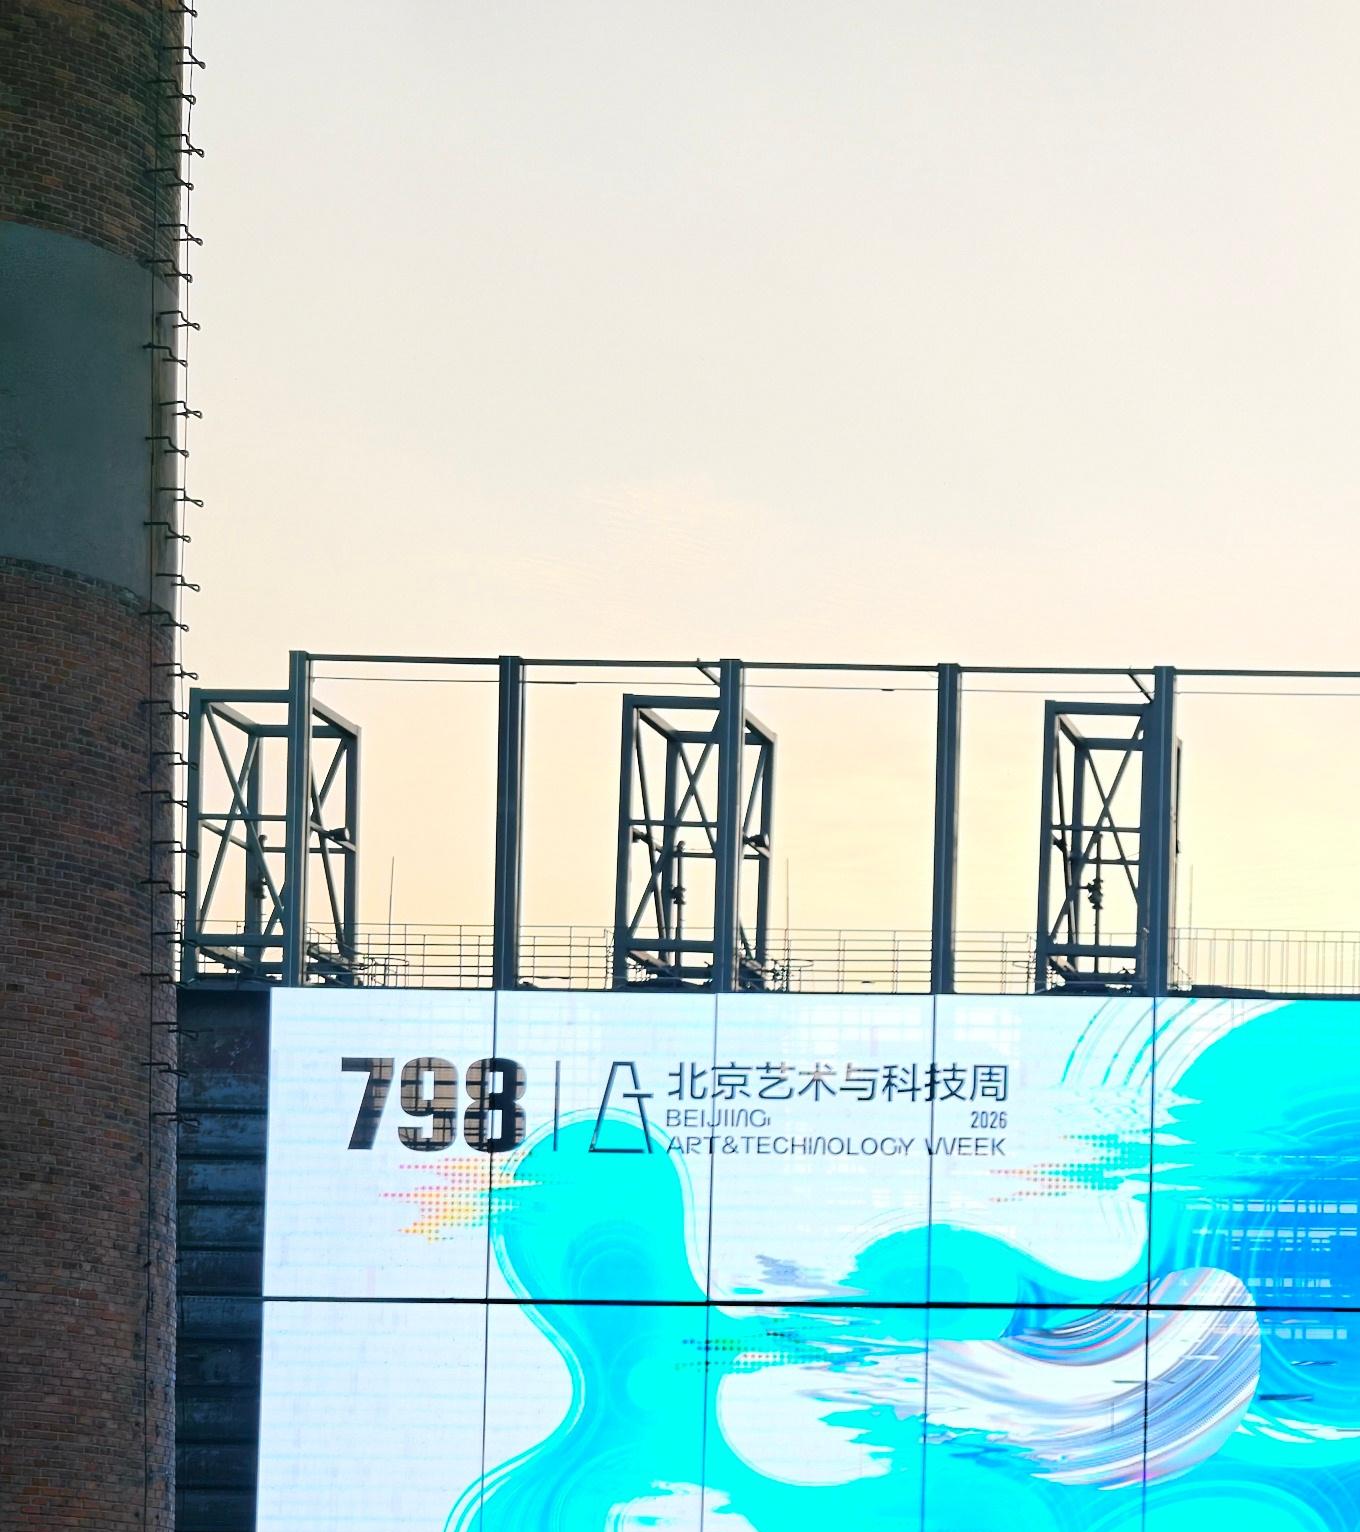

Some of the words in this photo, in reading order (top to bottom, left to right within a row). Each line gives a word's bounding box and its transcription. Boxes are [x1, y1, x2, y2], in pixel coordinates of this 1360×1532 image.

[667, 1061, 1009, 1102] 北京艺术与科技周
[341, 1056, 527, 1152] 798
[970, 1111, 1008, 1129] 2026
[925, 1137, 1007, 1156] WEEK
